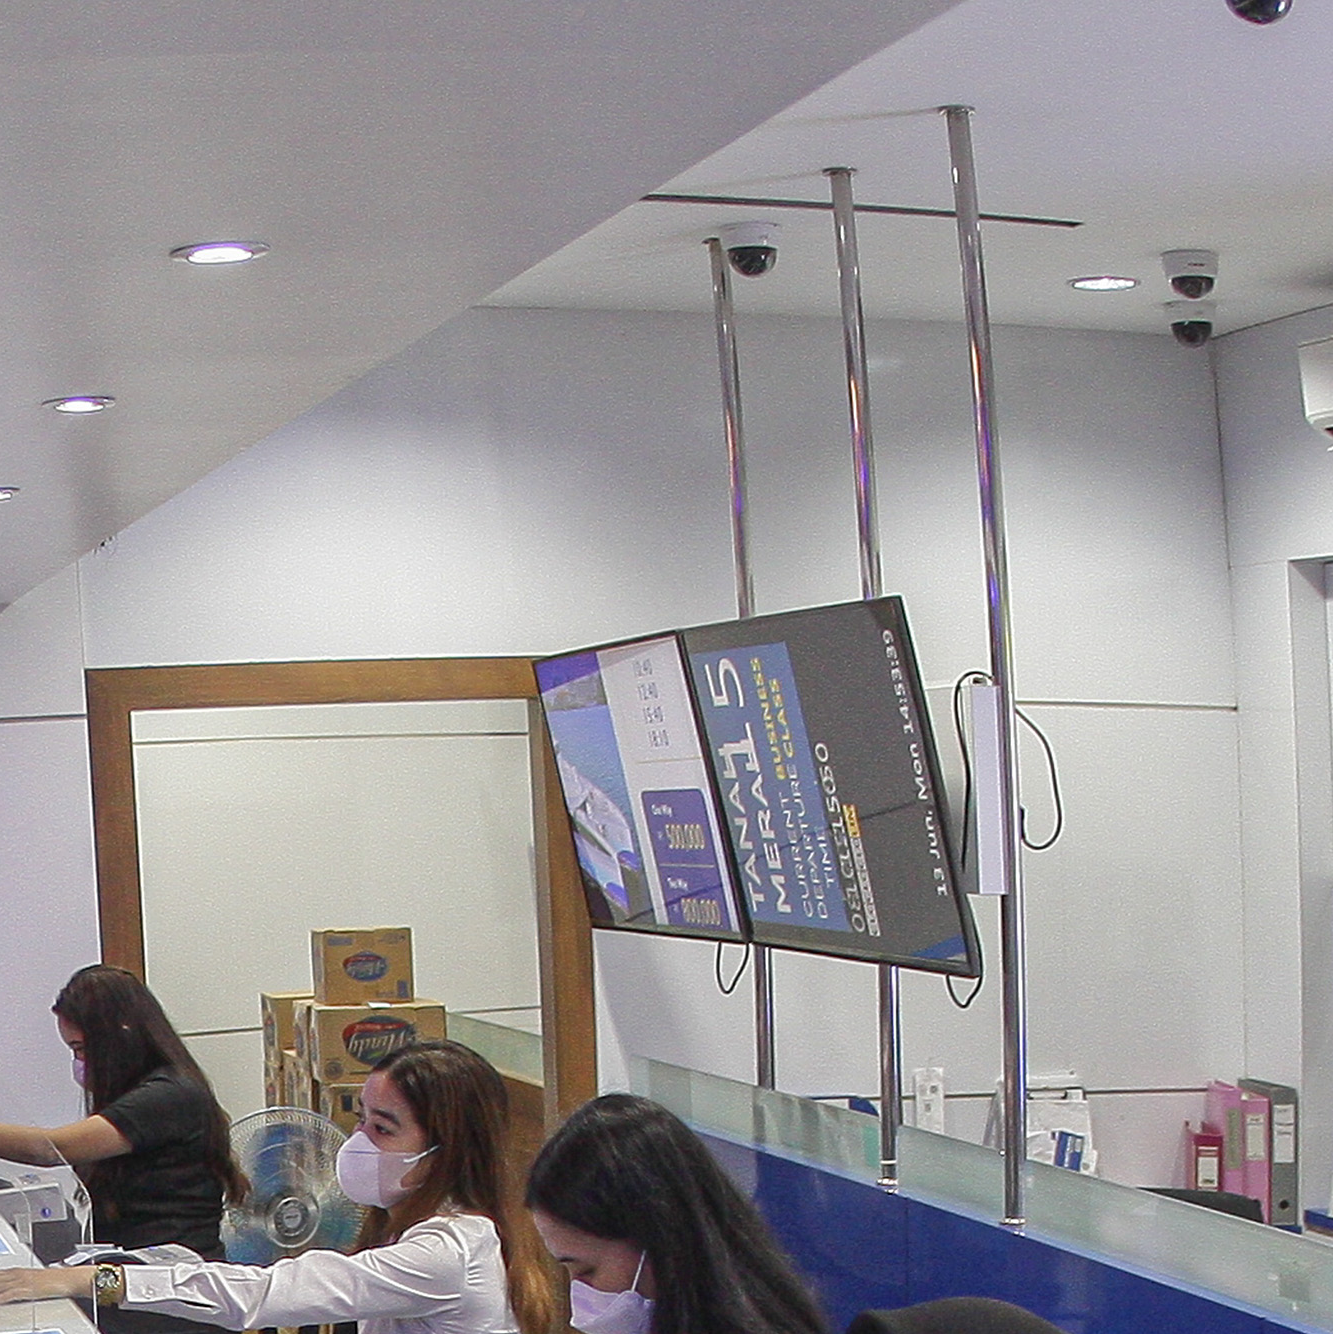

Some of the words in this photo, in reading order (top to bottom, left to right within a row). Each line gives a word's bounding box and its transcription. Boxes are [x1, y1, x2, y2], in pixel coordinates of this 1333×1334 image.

[750, 657, 787, 780] BUSINESS
[769, 678, 794, 758] CLASS
[909, 743, 928, 800] Mon
[778, 792, 813, 917] CURRENT
[786, 764, 829, 919] DEPARTURE
[815, 826, 835, 888] TIME
